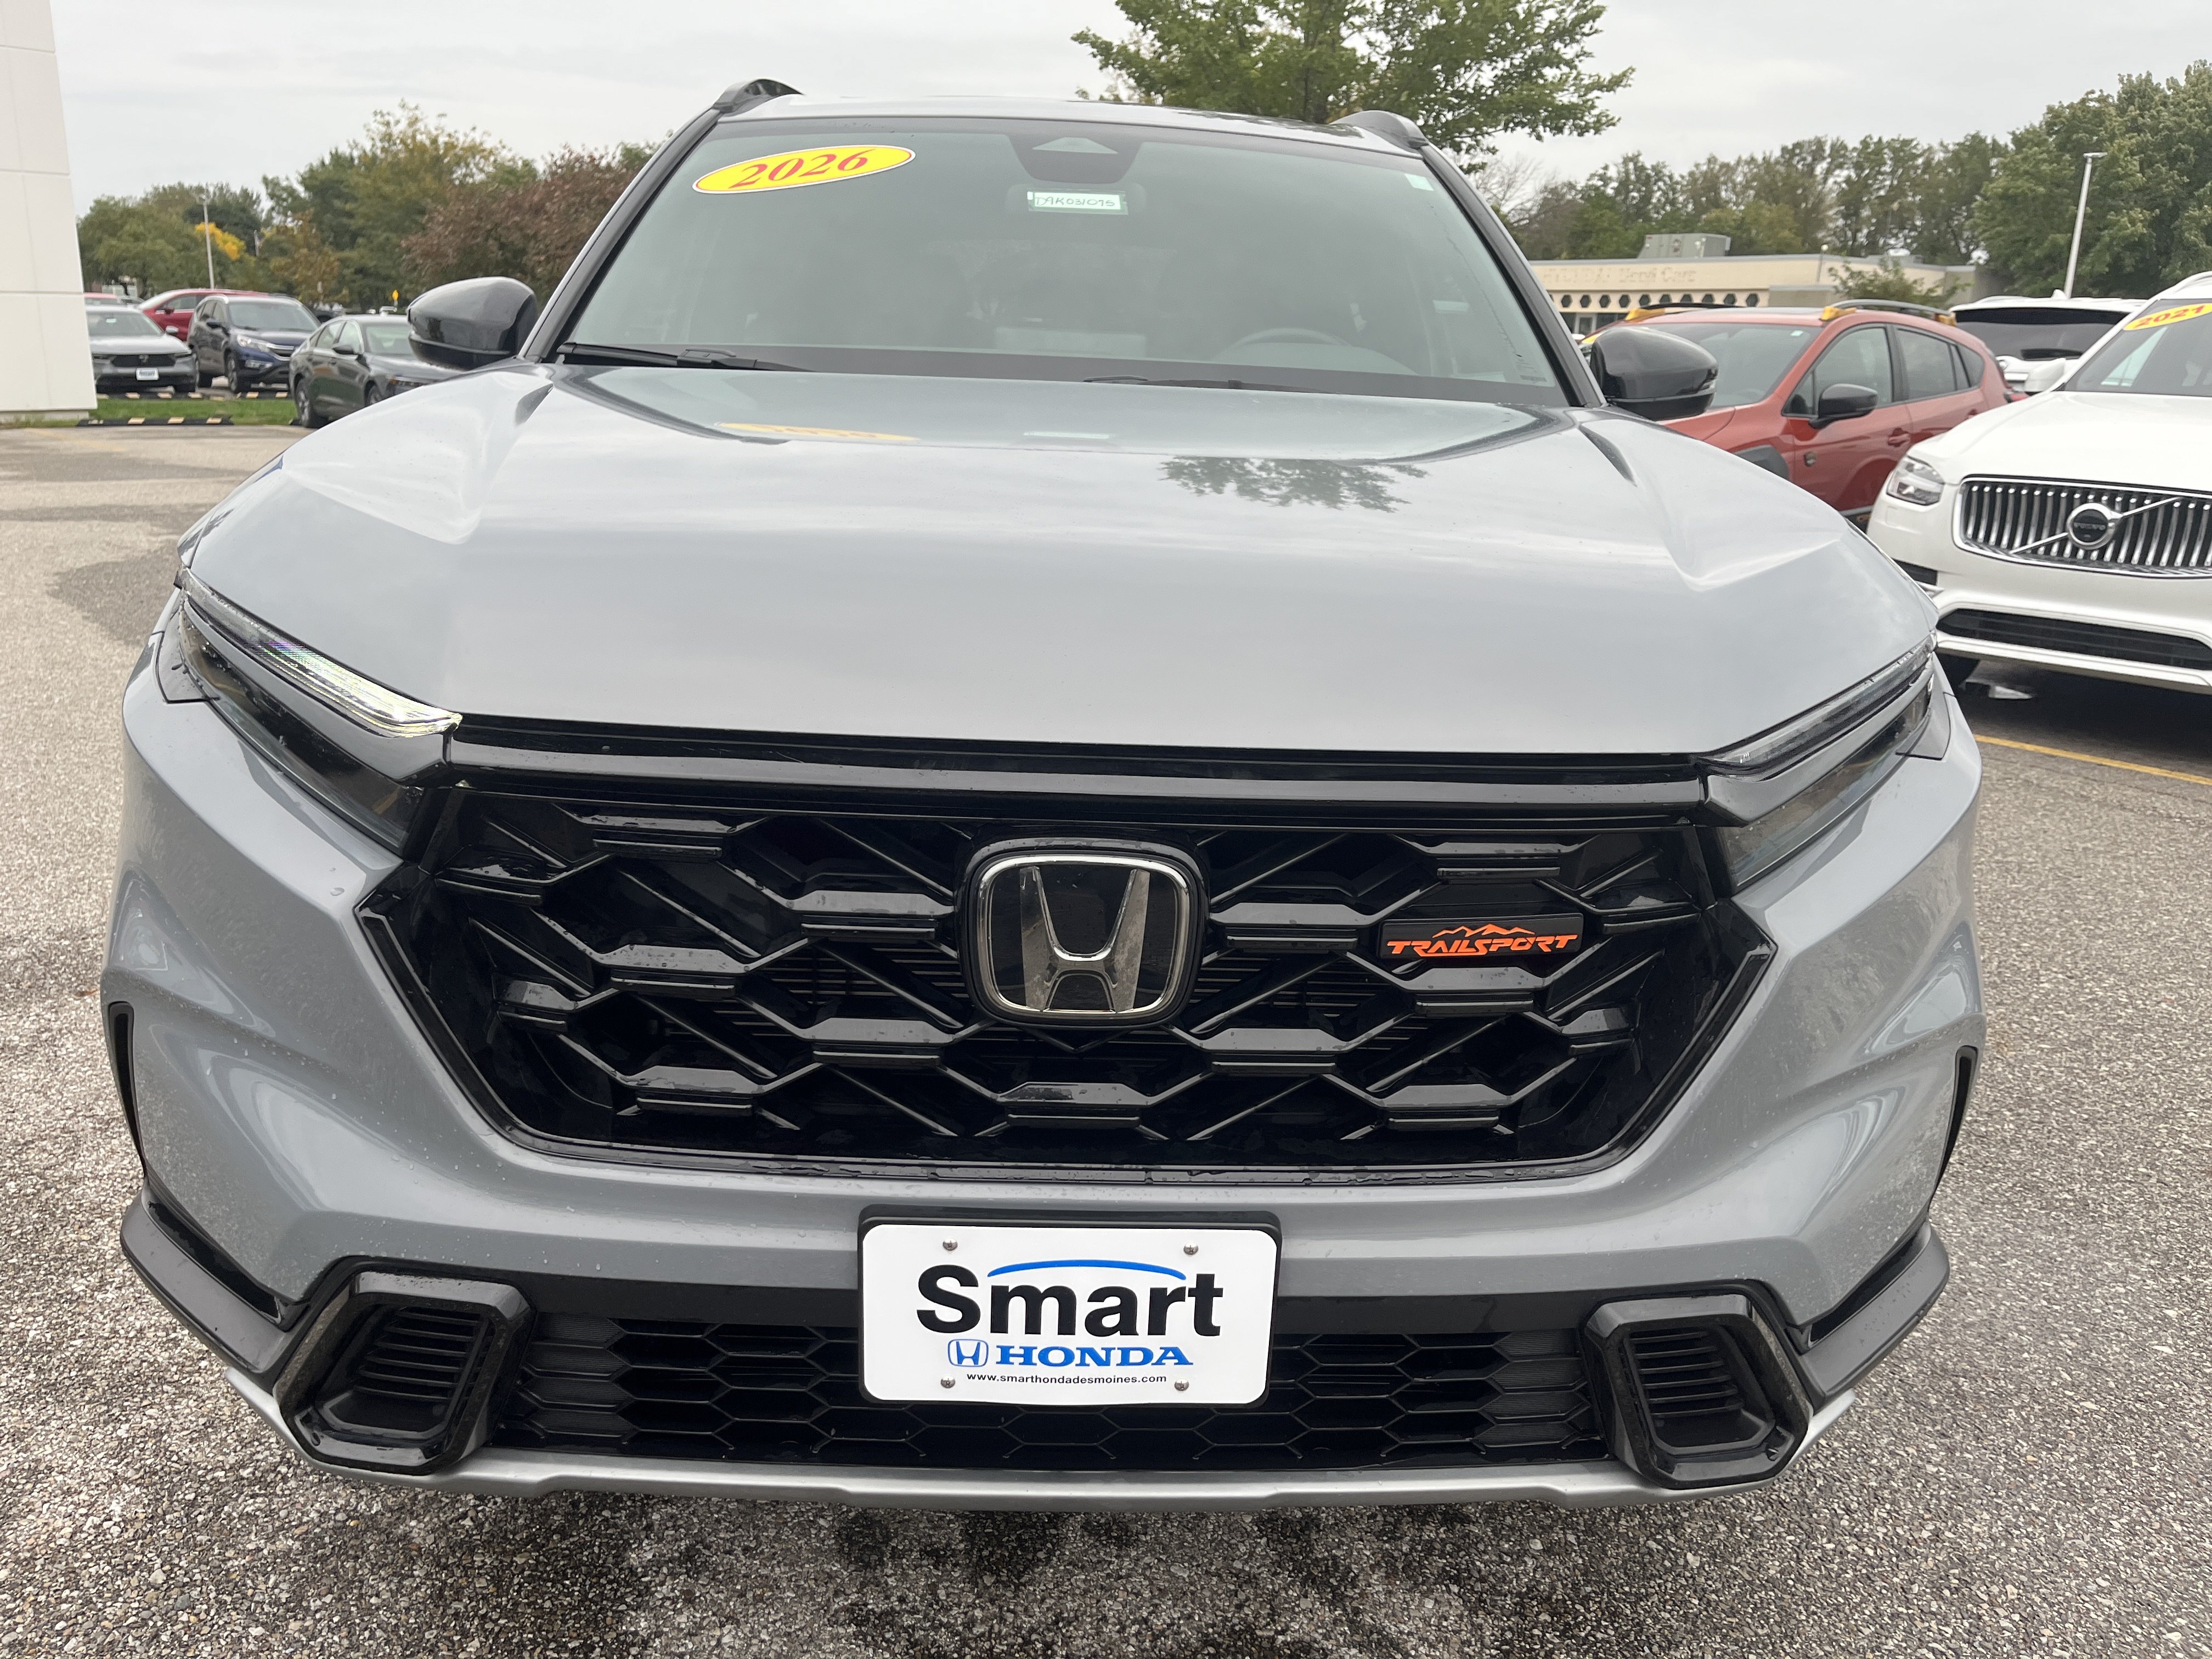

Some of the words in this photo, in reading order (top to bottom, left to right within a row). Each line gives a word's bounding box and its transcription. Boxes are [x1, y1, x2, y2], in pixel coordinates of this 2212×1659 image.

[728, 149, 876, 189] 2026
[2133, 305, 2205, 329] 2021
[1387, 934, 1578, 957] TRAILSPORT
[916, 1264, 1223, 1337] Smart
[996, 1345, 1193, 1367] HONDA
[966, 1373, 1167, 1384] www.smarthondadesmoines.com
